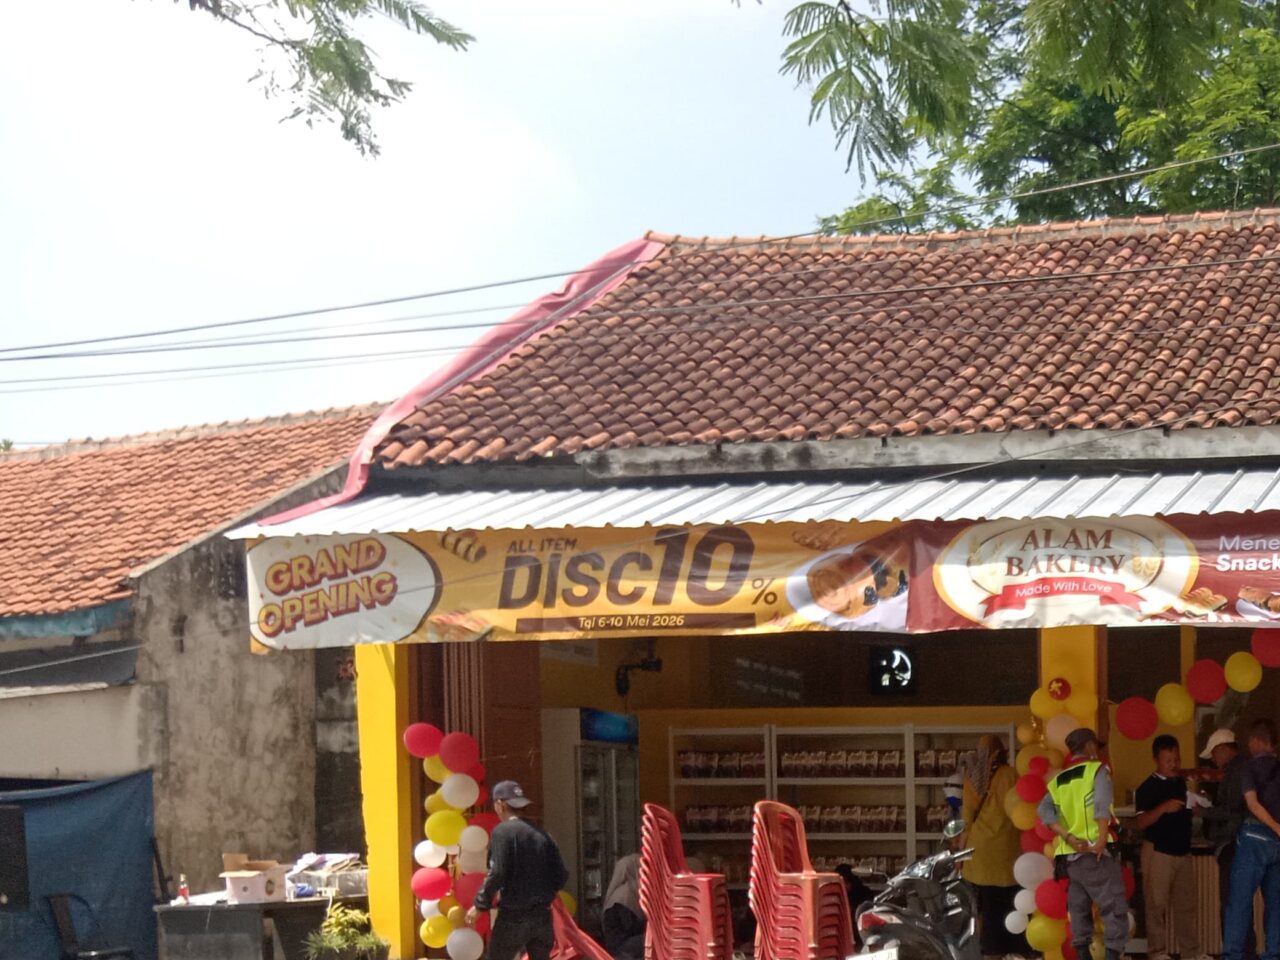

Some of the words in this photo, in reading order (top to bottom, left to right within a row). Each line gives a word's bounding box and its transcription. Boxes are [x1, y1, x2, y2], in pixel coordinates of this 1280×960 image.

[509, 539, 535, 554] ALL
[540, 537, 577, 552] ITEM
[1020, 528, 1114, 551] ALAM
[265, 537, 387, 596] GRAND
[1005, 554, 1125, 576] BAKERY
[1015, 584, 1050, 598] Made
[1053, 581, 1081, 592] With
[1082, 581, 1113, 594] Love
[258, 571, 398, 637] OPENING
[598, 616, 623, 628] 6-10
[626, 615, 650, 627] Mei
[652, 615, 685, 626] 2026
